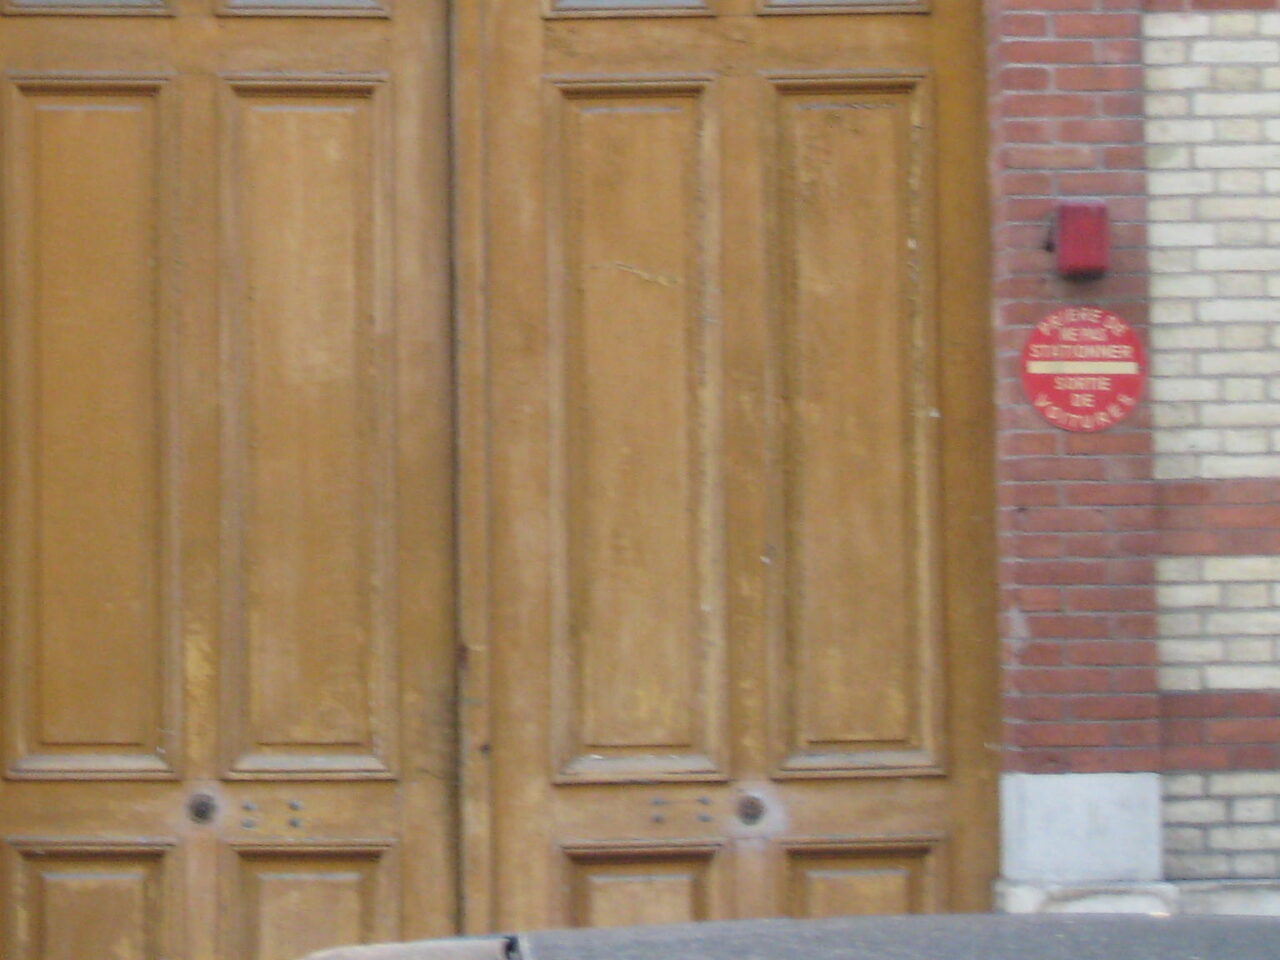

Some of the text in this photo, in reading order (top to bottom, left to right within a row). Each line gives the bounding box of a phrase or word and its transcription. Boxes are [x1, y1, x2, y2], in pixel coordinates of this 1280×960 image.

[1103, 314, 1129, 336] DE
[1061, 328, 1079, 342] NE
[1029, 344, 1134, 359] STATIONNER
[1054, 376, 1112, 391] SORTIE
[1070, 393, 1096, 408] DE
[1035, 393, 1136, 429] VOITURES
